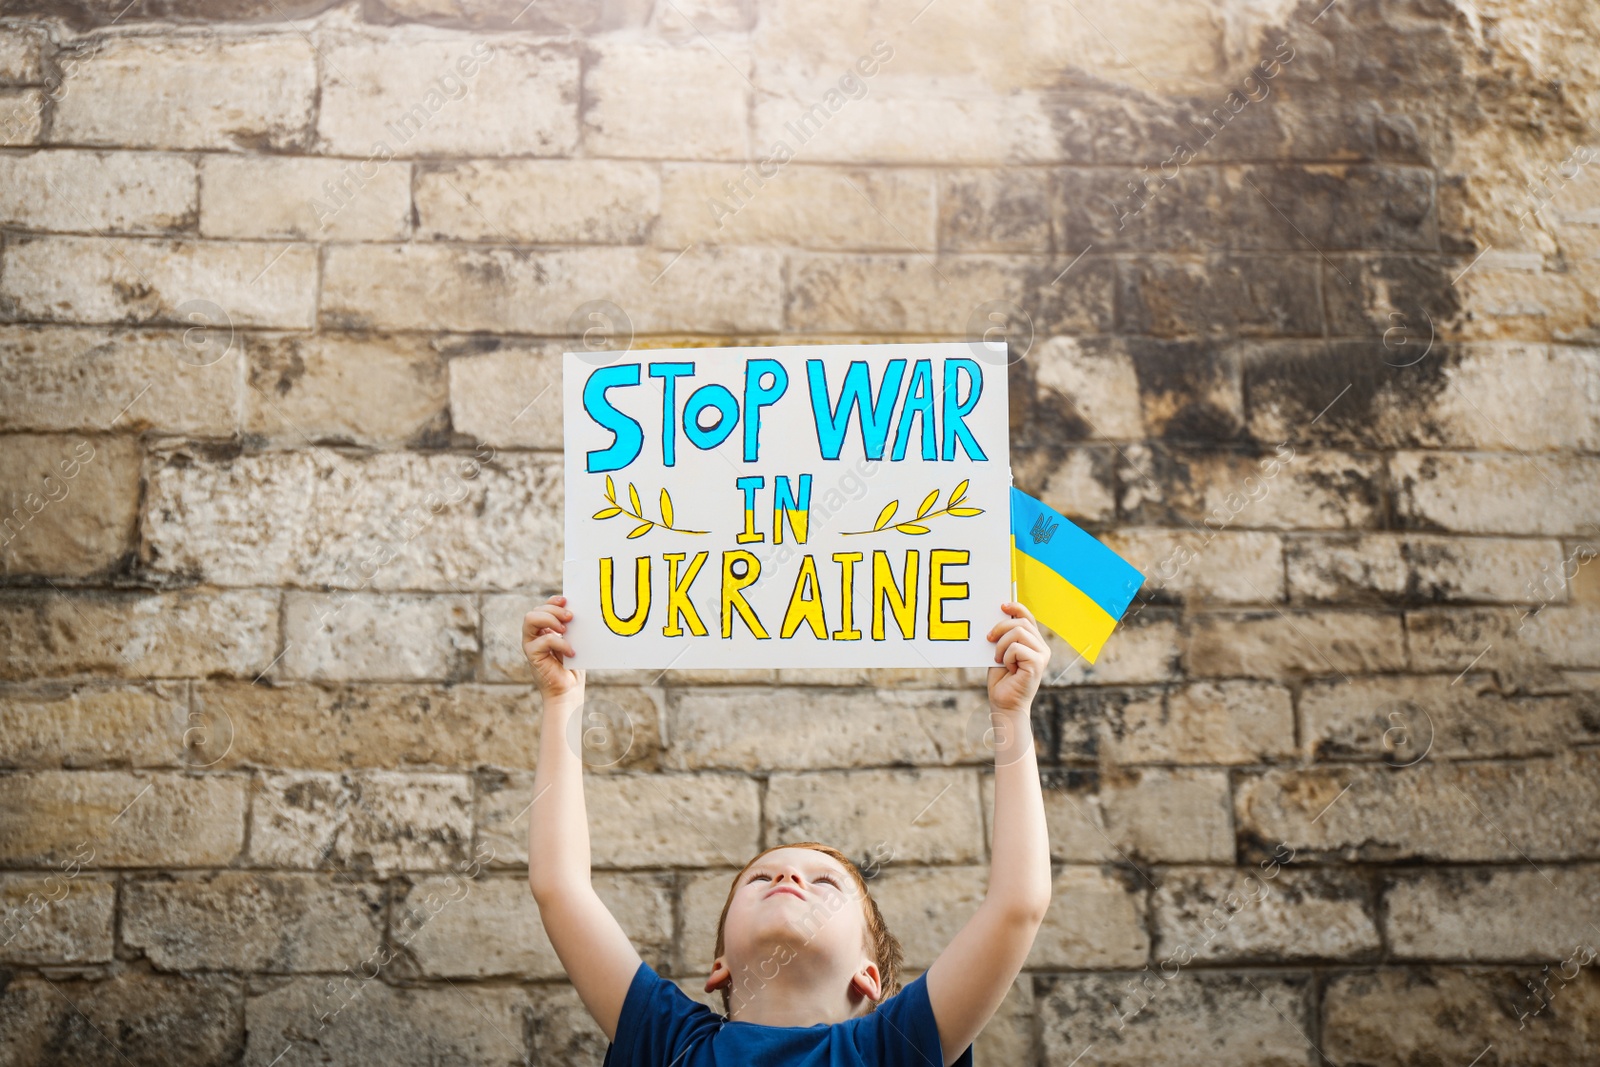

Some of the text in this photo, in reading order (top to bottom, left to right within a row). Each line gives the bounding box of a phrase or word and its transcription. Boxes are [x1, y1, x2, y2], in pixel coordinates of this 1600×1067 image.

[583, 358, 989, 474] STOP WAR
[735, 474, 813, 545] IN
[598, 549, 972, 641] UKRAINE
